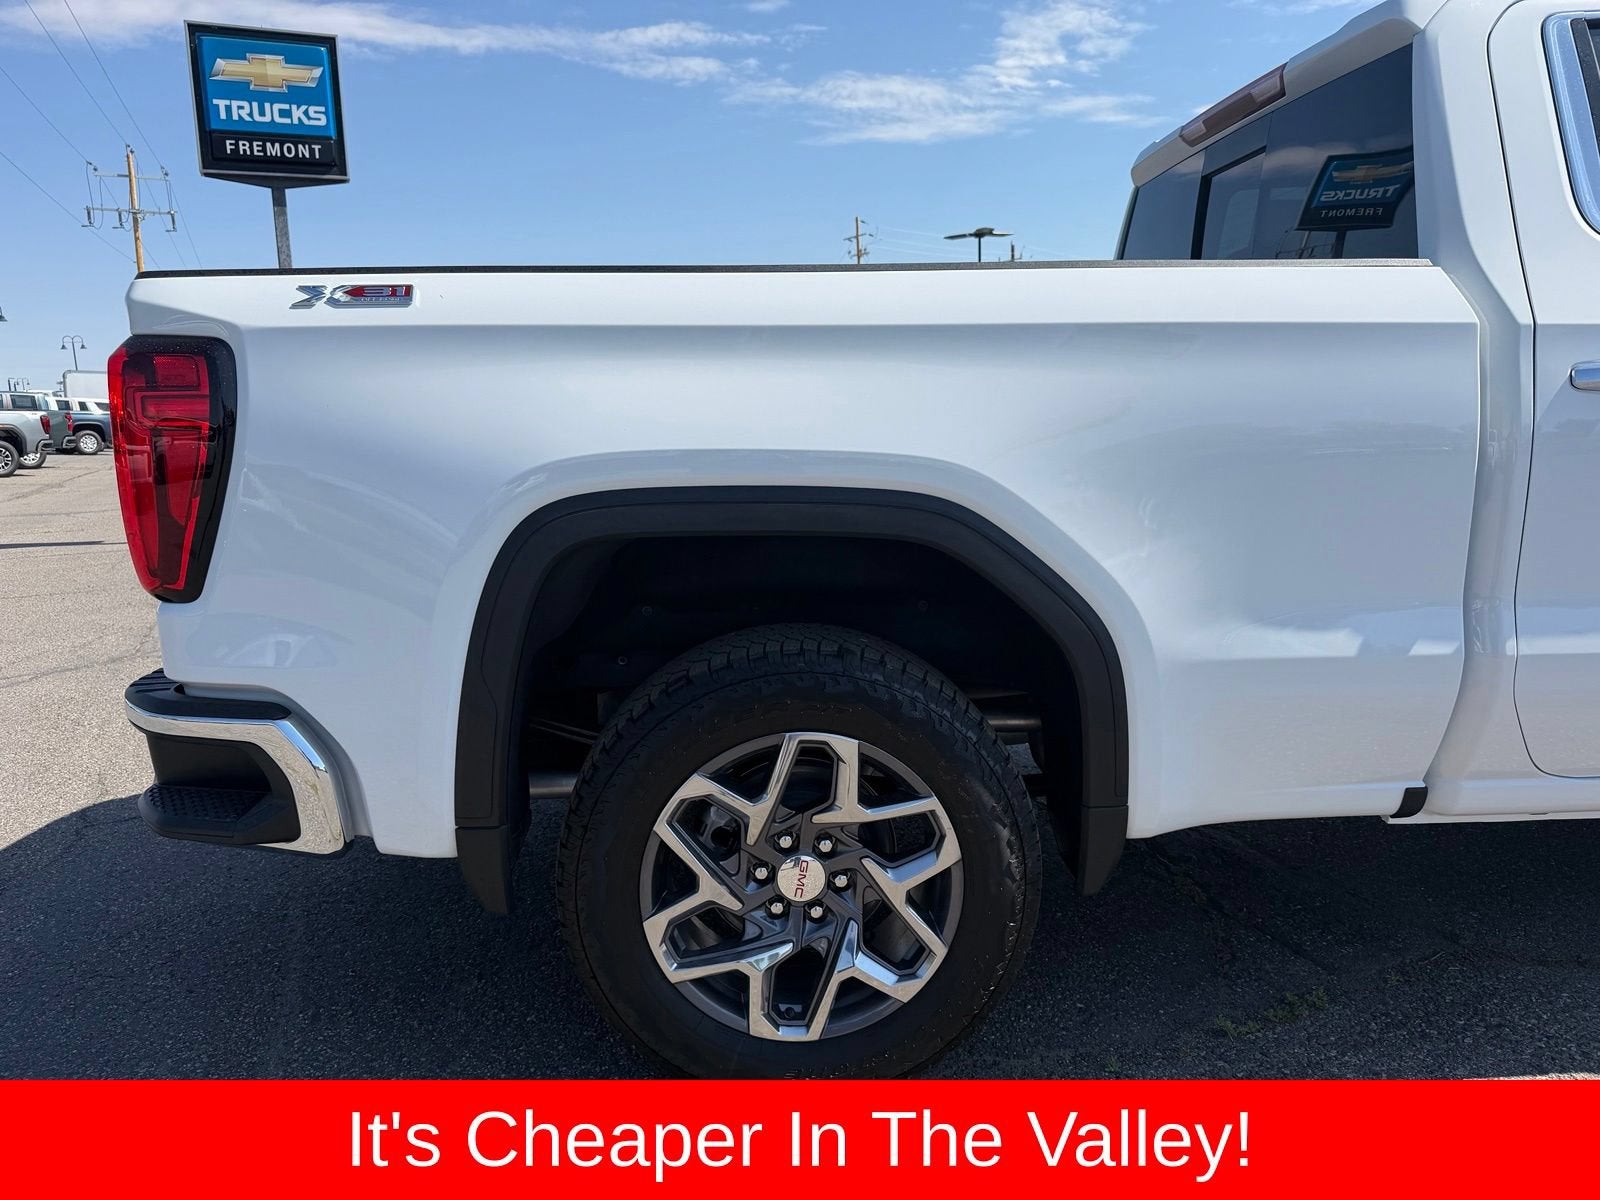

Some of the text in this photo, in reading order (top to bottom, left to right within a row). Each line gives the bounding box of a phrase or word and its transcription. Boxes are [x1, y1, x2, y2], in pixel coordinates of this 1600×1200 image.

[212, 99, 327, 126] TRUCKS
[225, 140, 322, 159] FREMONT
[794, 860, 809, 898] GMC
